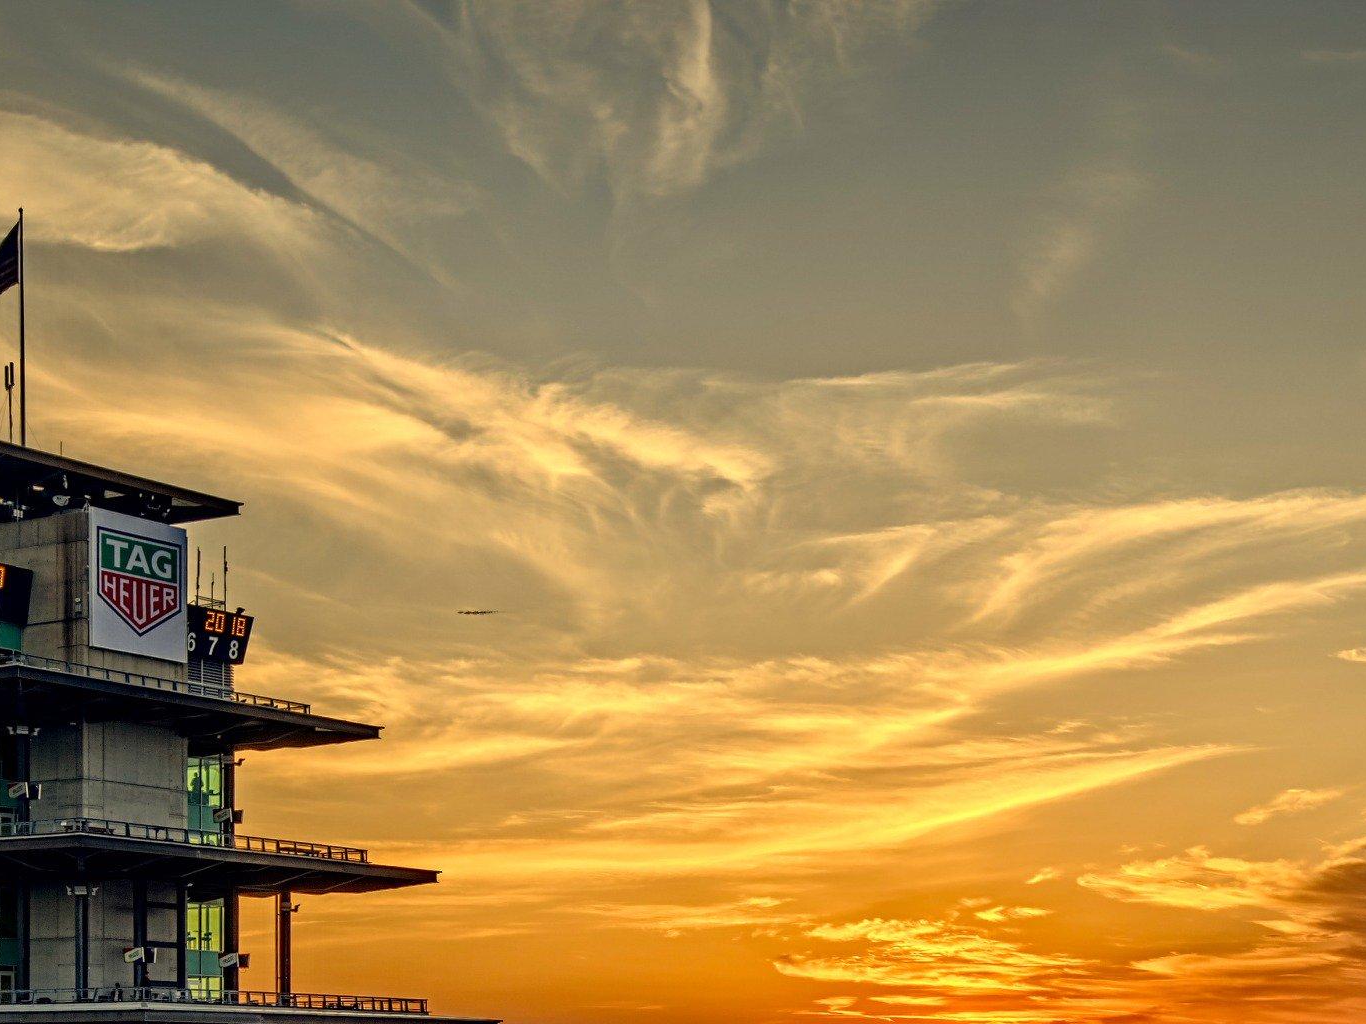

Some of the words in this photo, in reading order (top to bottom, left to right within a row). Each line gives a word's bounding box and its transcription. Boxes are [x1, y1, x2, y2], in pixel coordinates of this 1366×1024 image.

[104, 538, 174, 579] TAG
[103, 574, 175, 624] HEUER
[208, 636, 219, 656] 7
[228, 640, 239, 660] 8
